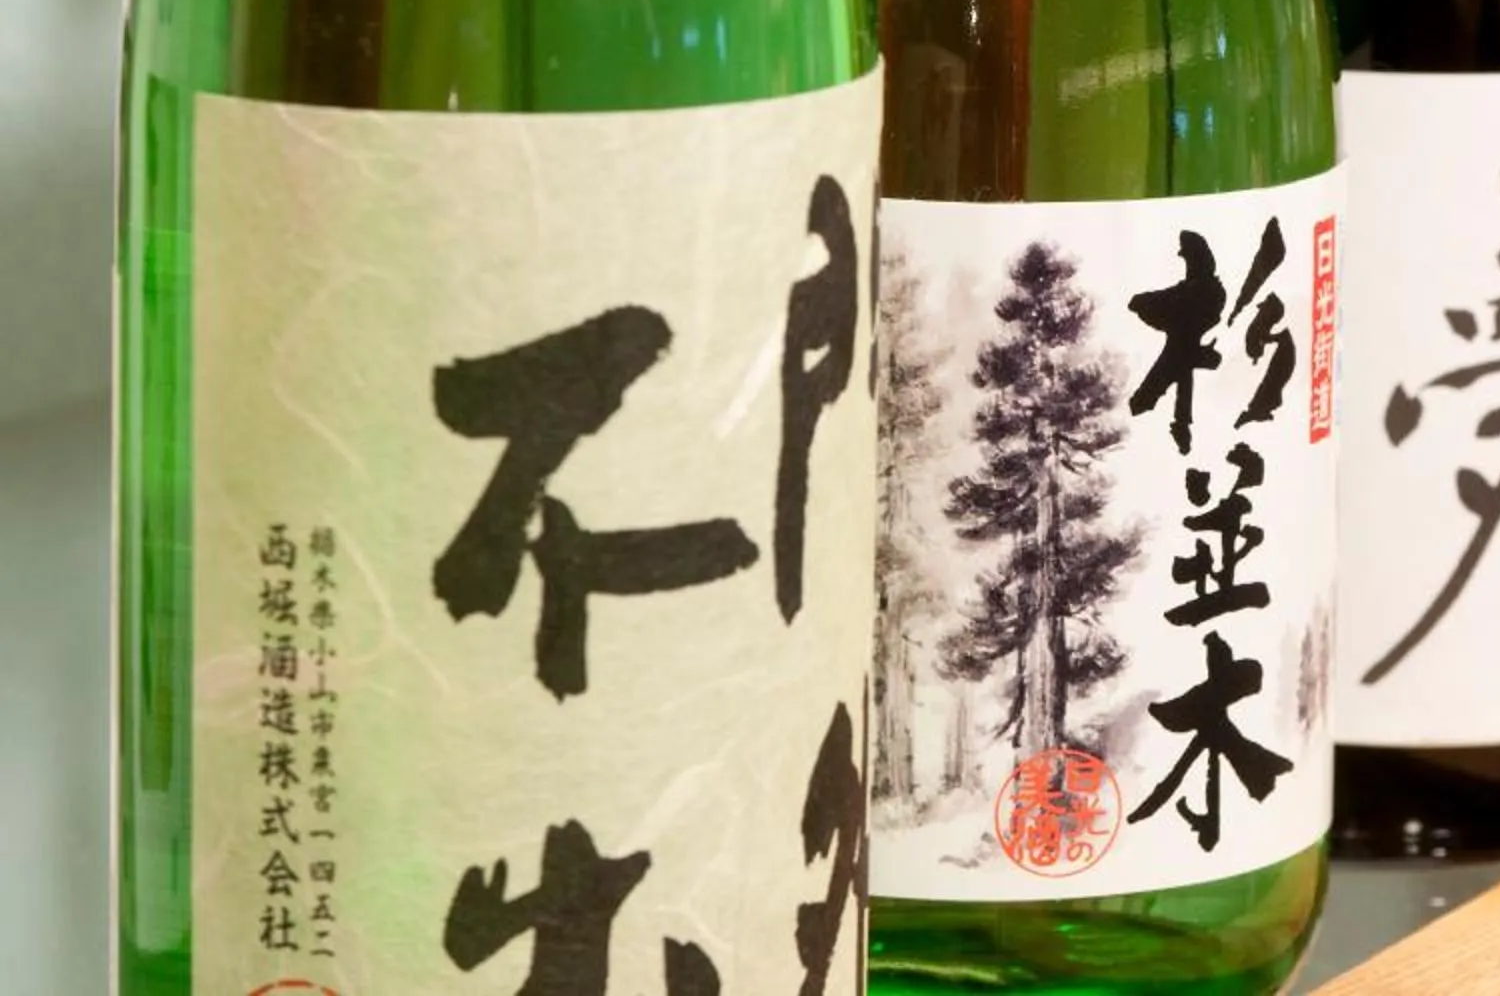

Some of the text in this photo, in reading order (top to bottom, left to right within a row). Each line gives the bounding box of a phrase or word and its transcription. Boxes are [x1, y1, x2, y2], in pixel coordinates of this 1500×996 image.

[258, 523, 301, 952] 西堀酒造株式会社
[1127, 215, 1295, 853] 杉並木
